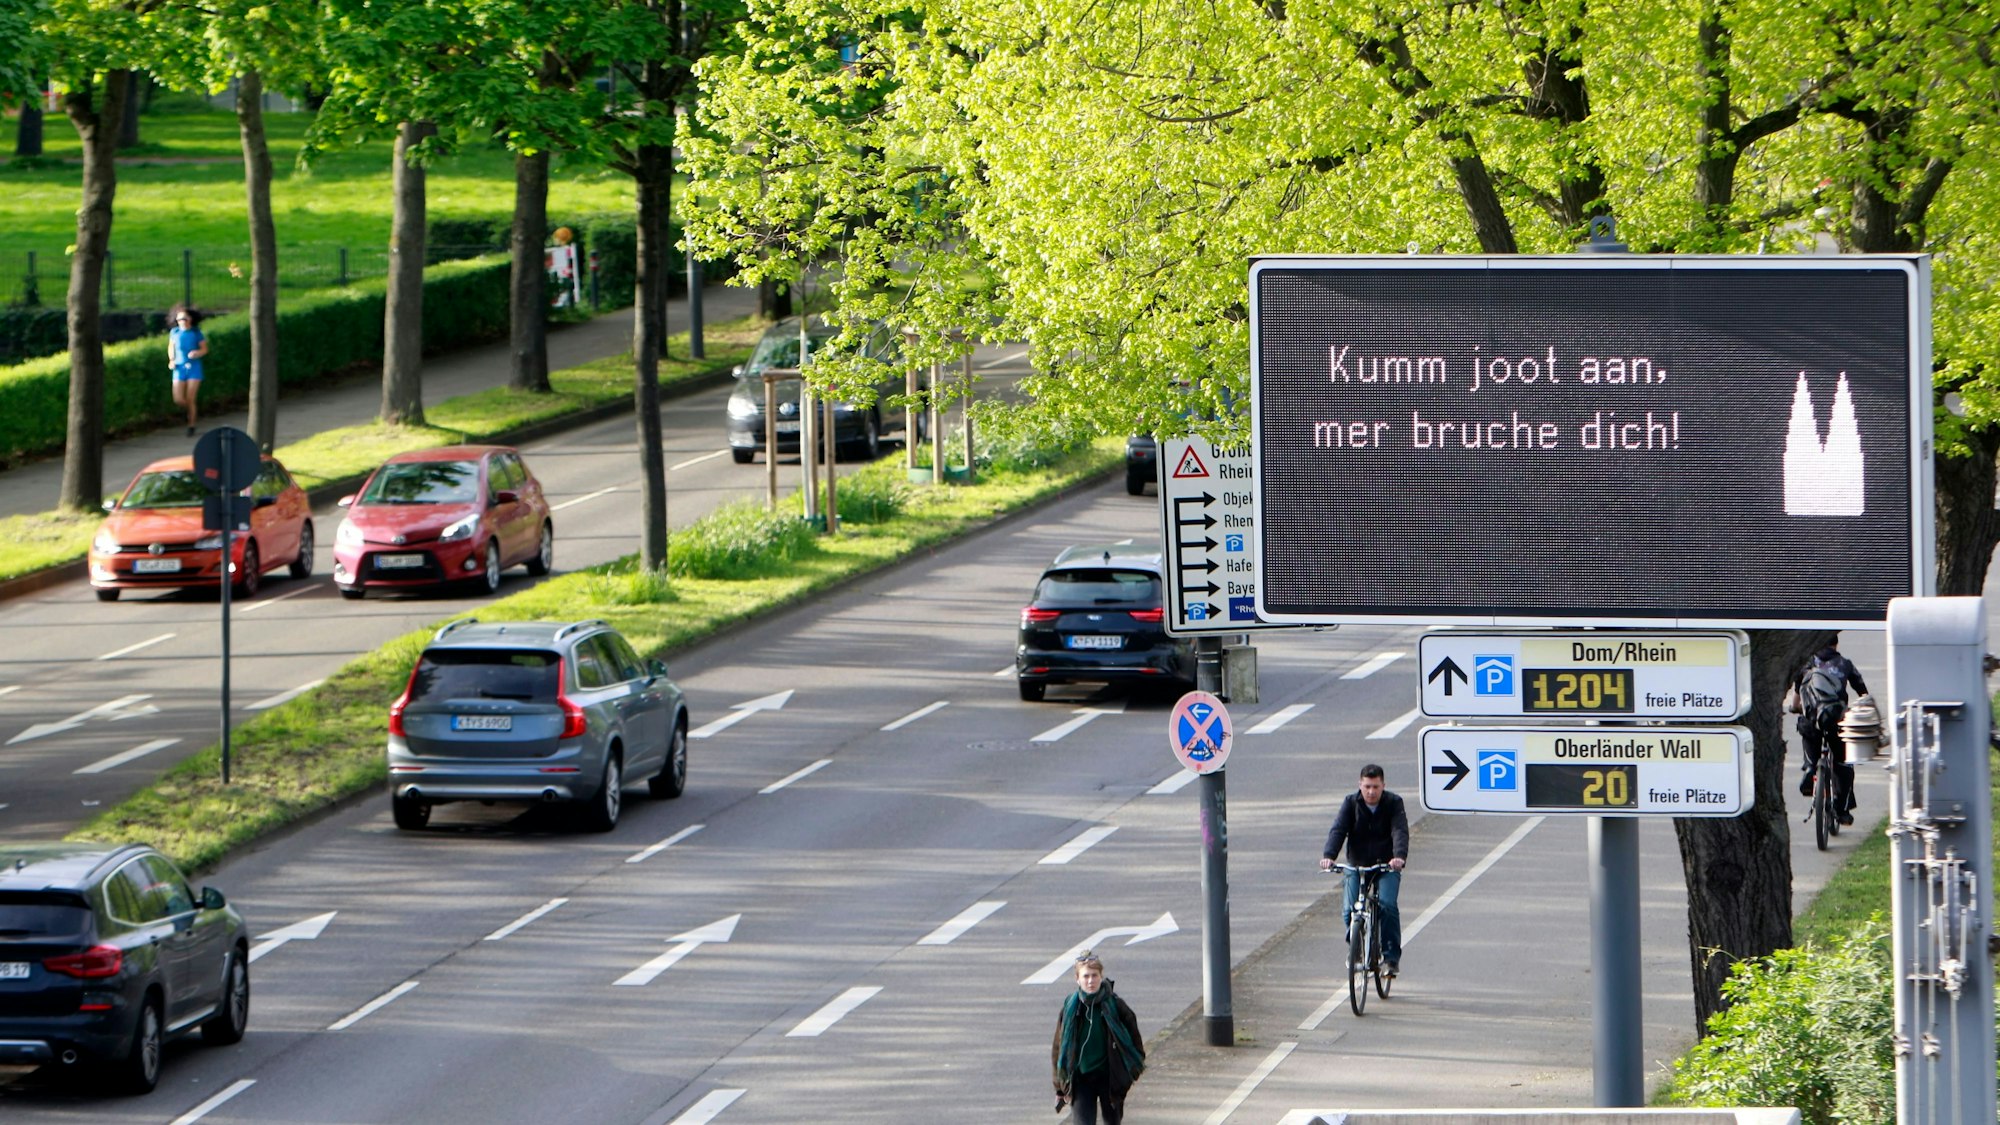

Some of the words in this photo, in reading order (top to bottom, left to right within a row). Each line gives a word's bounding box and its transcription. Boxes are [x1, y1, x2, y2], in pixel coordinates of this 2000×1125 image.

[1330, 345, 1446, 383] Kumm
[1470, 346, 1560, 391] joot
[1580, 358, 1667, 386] aan,
[1313, 418, 1390, 450] mer
[1413, 412, 1558, 450] bruche
[1581, 412, 1680, 450] dich!
[1572, 642, 1677, 663] Dom/Rhein
[1532, 673, 1626, 709] 1204
[1645, 692, 1676, 708] freie
[1682, 692, 1723, 708] Plätze
[1554, 738, 1654, 759] Oberländer
[1660, 739, 1701, 759] Wall
[1582, 770, 1628, 806] 20
[1649, 788, 1680, 803] freie
[1685, 788, 1726, 804] Plätze
